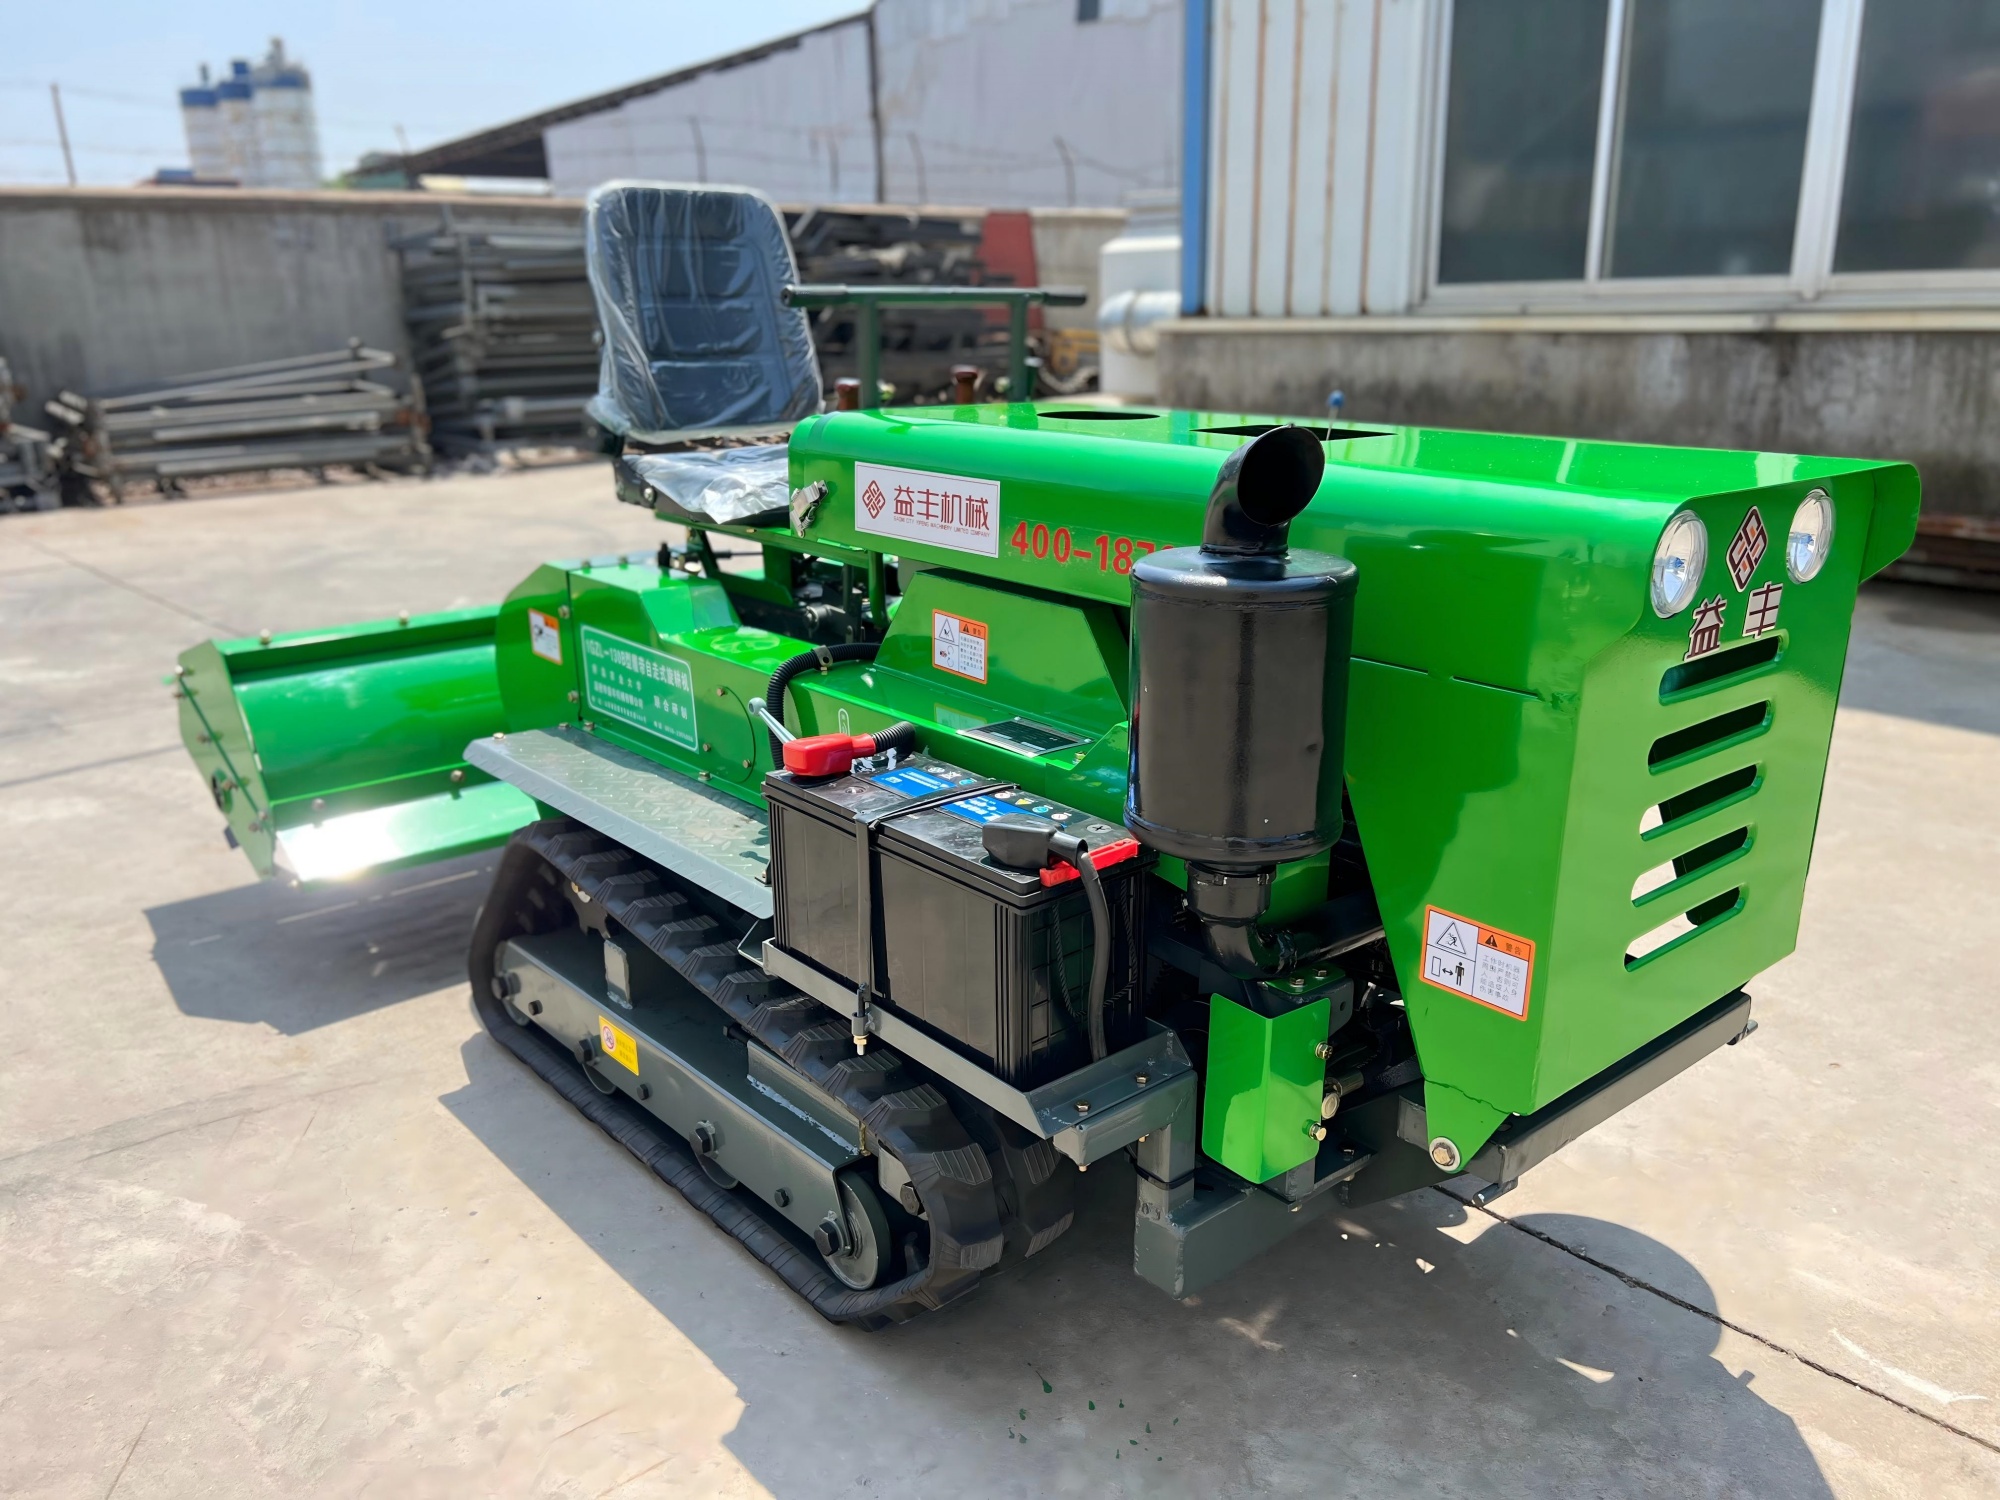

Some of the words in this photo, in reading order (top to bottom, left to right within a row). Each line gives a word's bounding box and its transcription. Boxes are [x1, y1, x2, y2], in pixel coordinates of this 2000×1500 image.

[893, 485, 990, 531] 益丰机械
[905, 517, 915, 525] CITY
[930, 522, 953, 533] MACHINERY
[953, 527, 969, 536] LIMITED
[969, 529, 990, 539] COMPANY
[1010, 520, 1175, 575] 400-187
[1505, 942, 1522, 955] 警告
